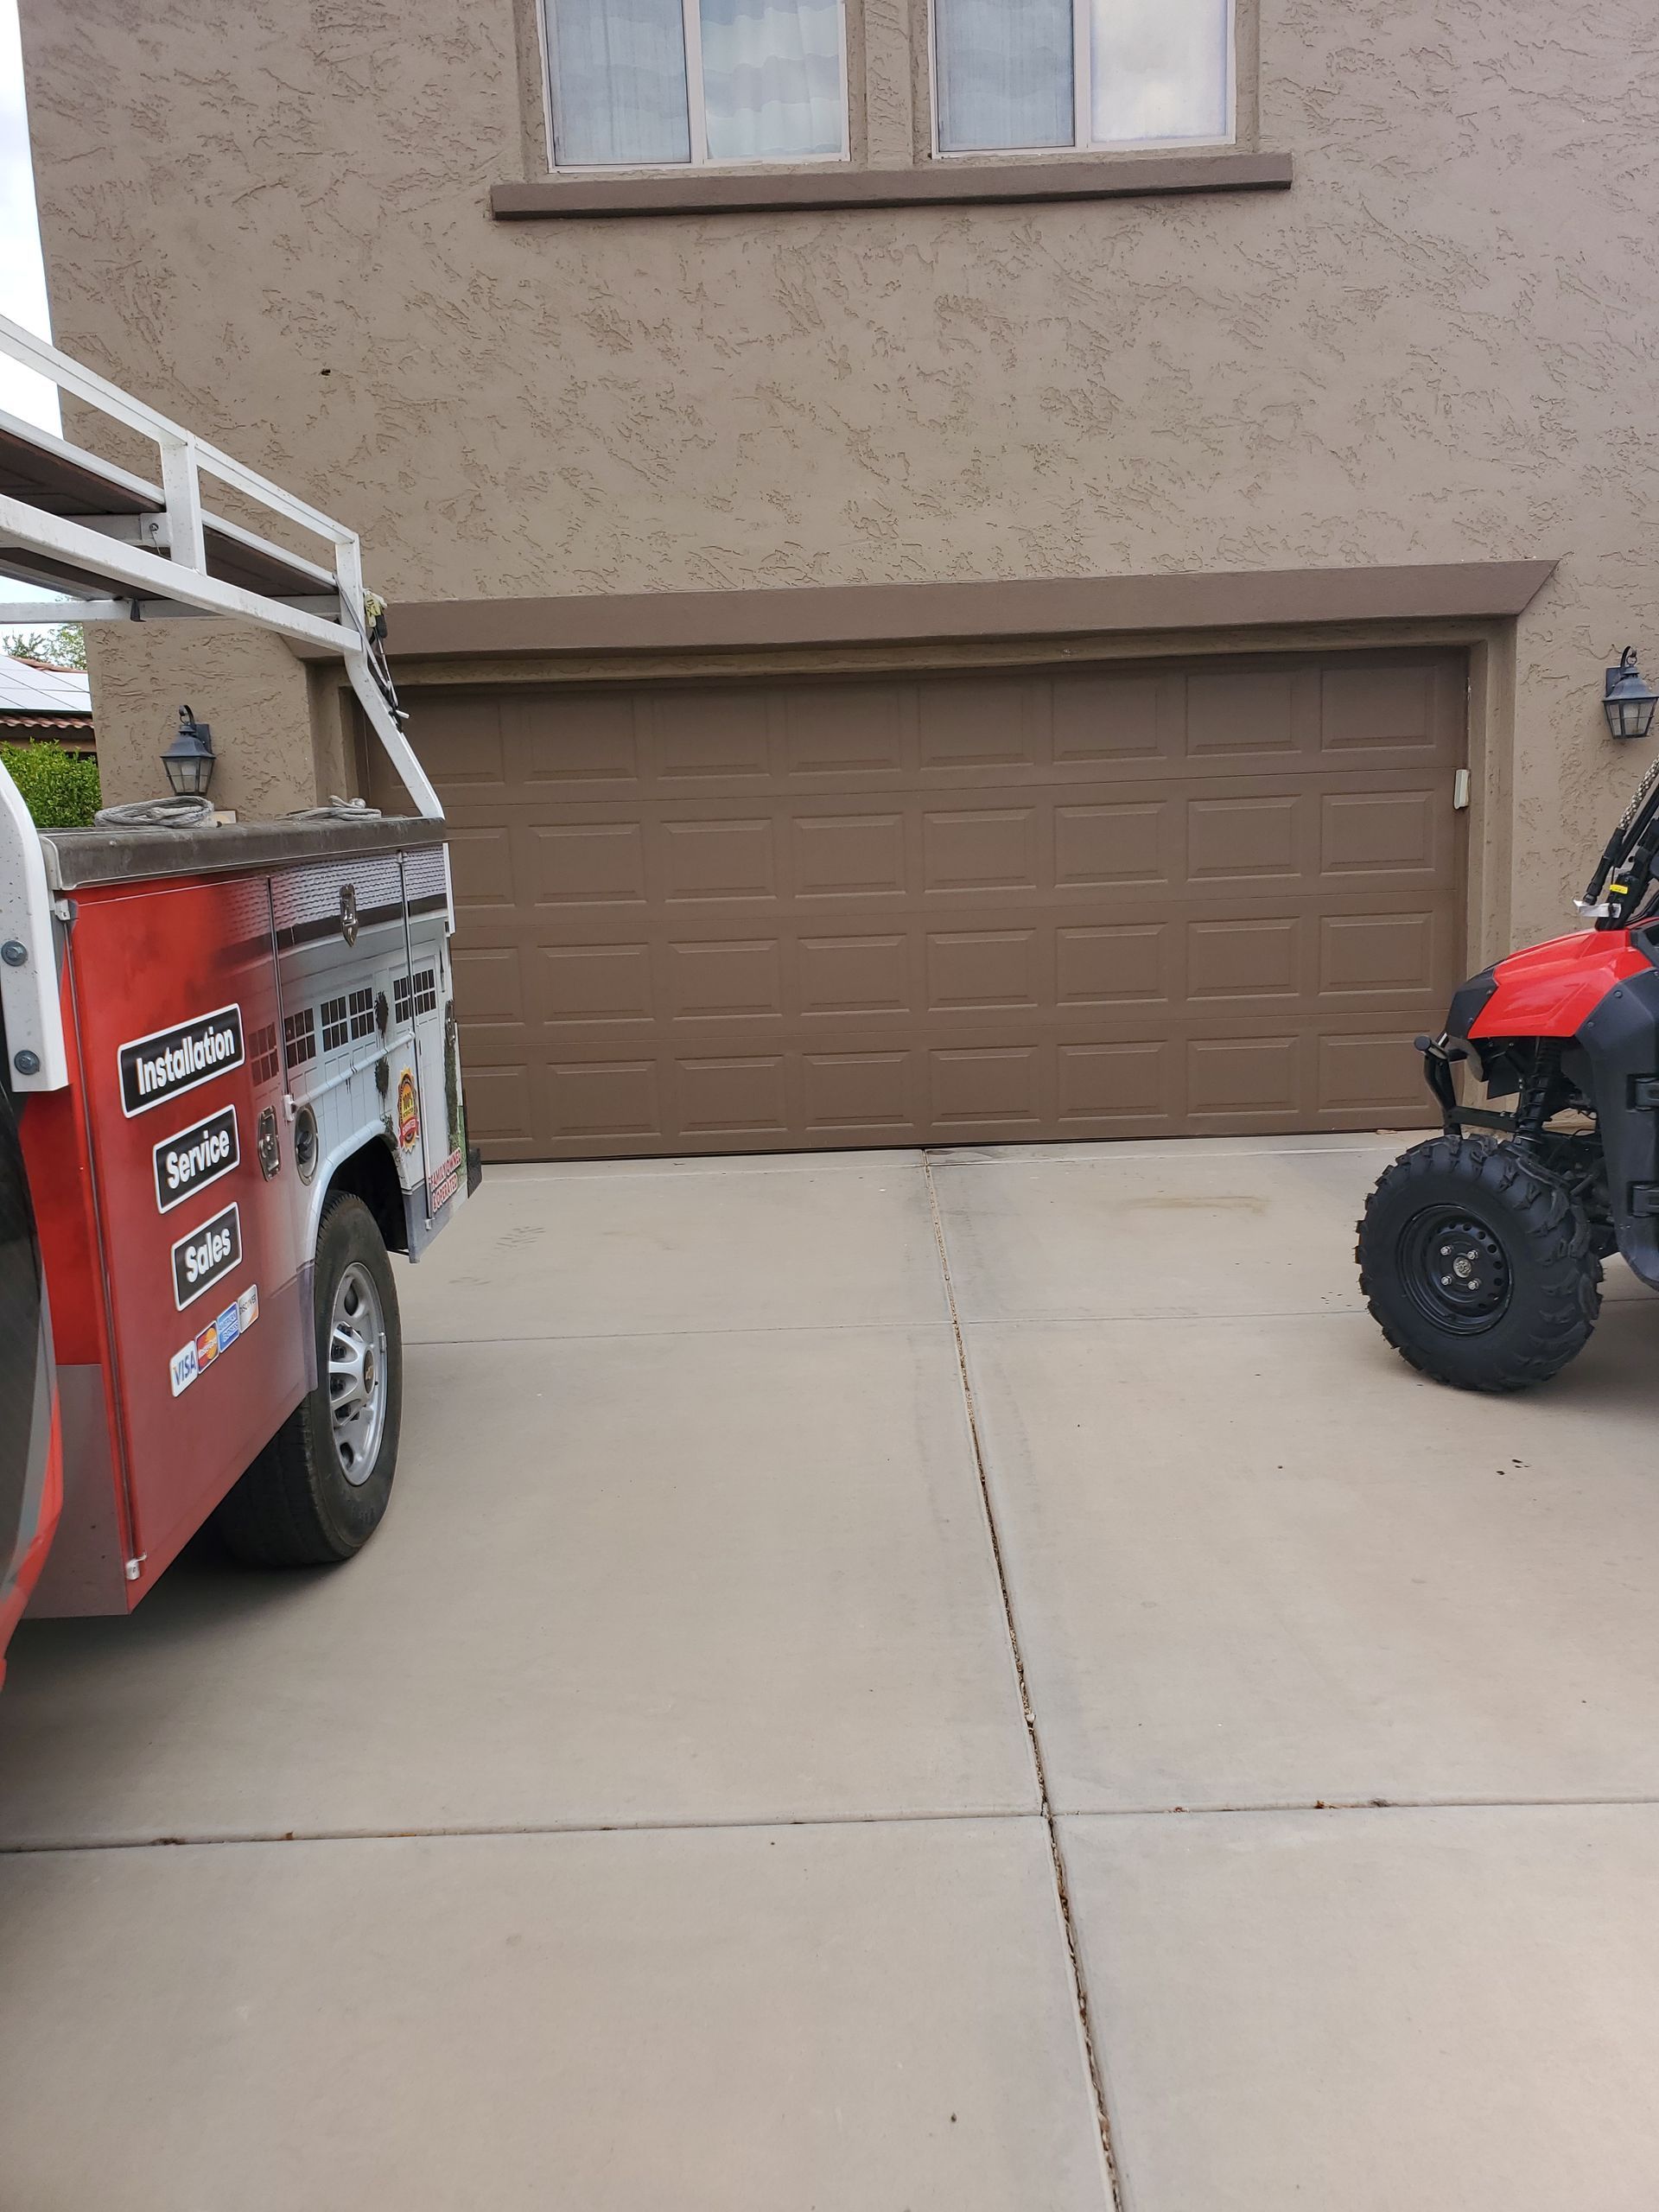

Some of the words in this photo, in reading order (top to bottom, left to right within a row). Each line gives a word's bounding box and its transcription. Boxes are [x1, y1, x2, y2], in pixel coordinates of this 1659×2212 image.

[137, 1026, 235, 1096] Installation
[166, 1130, 230, 1189] Service
[446, 1147, 461, 1175] OWNED
[185, 1228, 231, 1282] Sales
[173, 1351, 197, 1385] VISA
